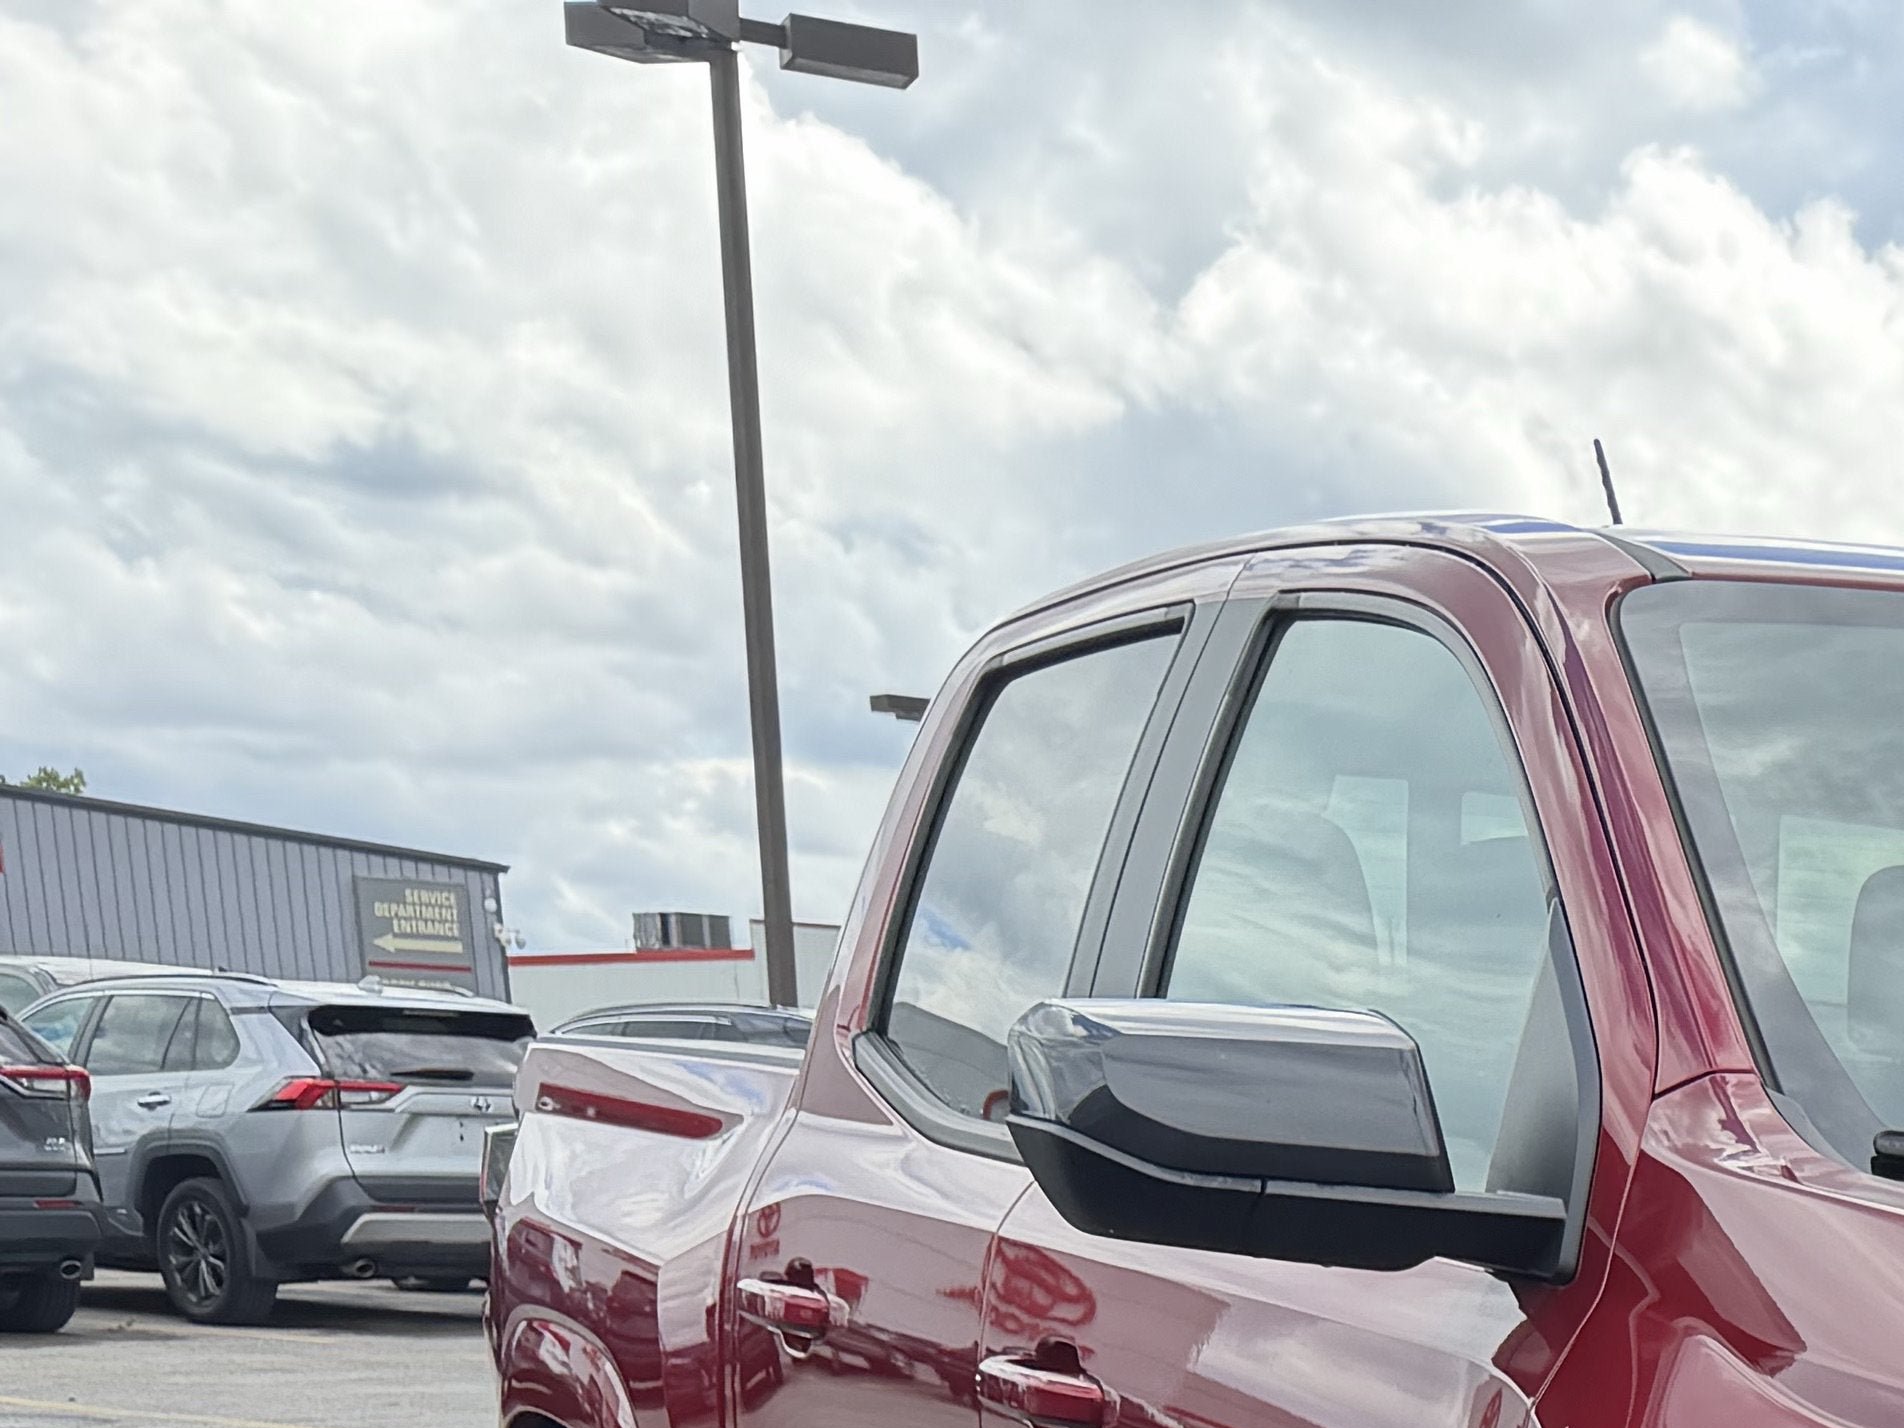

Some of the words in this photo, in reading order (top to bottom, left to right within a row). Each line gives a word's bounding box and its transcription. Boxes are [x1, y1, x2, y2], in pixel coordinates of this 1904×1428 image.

[404, 888, 456, 905] SERVICE
[374, 901, 458, 920] DEPARTMENT
[392, 918, 460, 937] ENTRANCE
